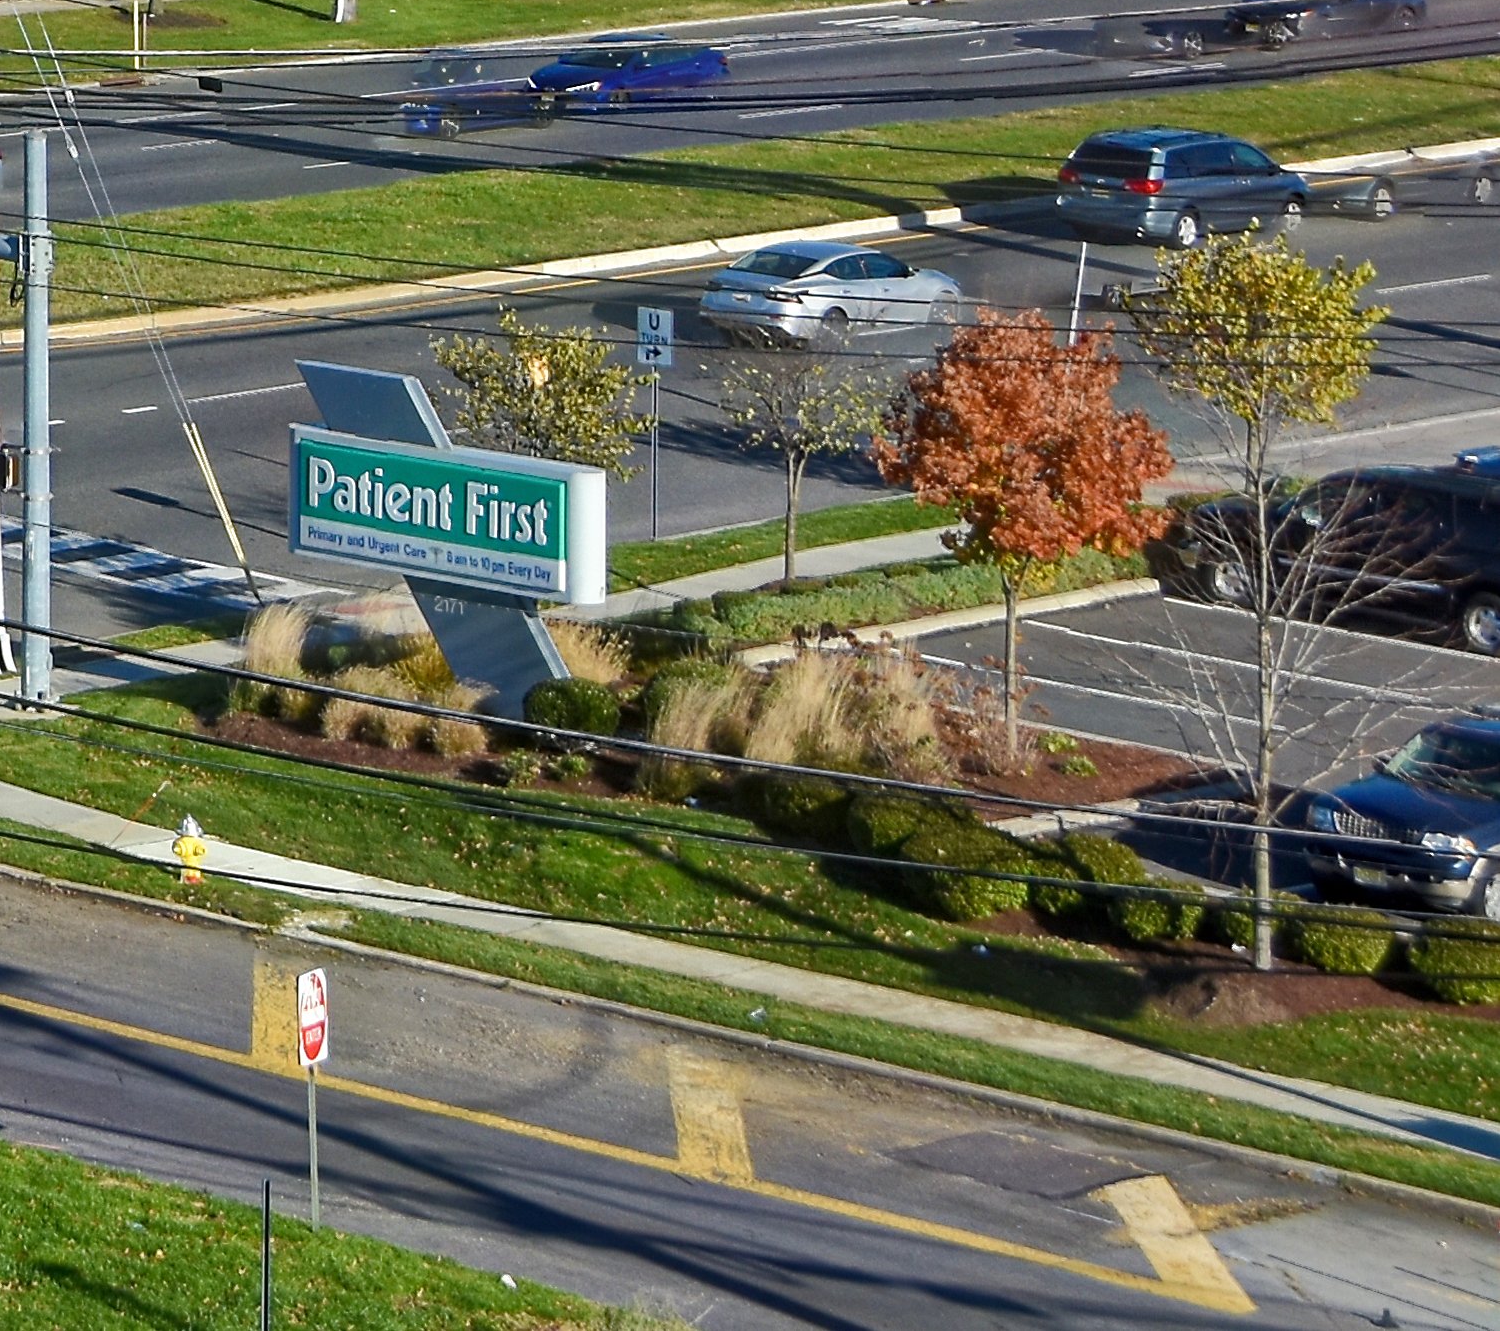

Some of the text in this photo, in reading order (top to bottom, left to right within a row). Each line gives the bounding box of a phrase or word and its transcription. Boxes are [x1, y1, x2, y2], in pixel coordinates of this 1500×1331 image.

[648, 312, 660, 331] U
[642, 332, 668, 345] TURN
[308, 455, 548, 546] Patient First
[308, 525, 551, 583] Primary and Urgent Care 8 am to 10 pm Every Day
[434, 595, 464, 616] 2171
